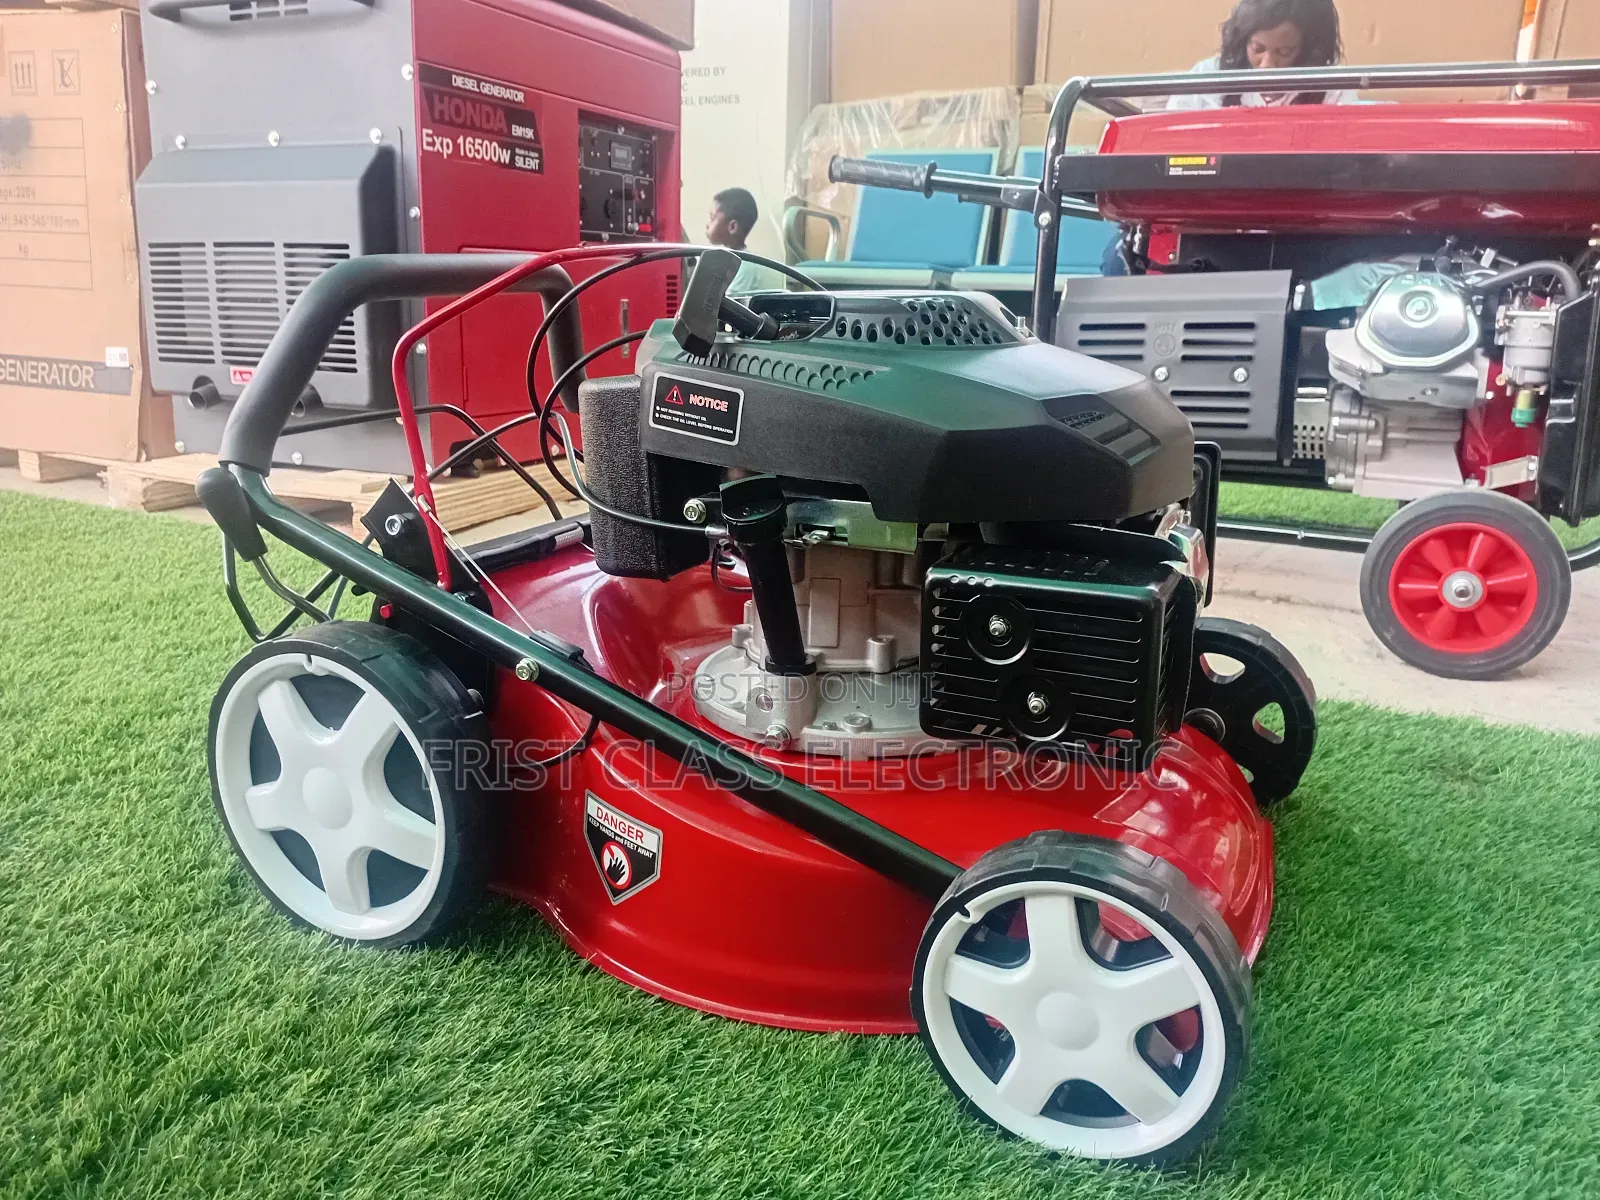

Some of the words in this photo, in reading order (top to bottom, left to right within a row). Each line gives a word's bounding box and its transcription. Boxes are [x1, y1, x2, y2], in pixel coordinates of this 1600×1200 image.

[452, 74, 479, 92] DIESEL
[480, 82, 525, 103] GENERATOR
[698, 94, 741, 105] ENGINES
[433, 92, 508, 134] HONDA
[422, 128, 453, 160] Exp
[512, 124, 535, 140] EM15K
[515, 156, 540, 171] SILENT
[18, 242, 29, 257] kg
[689, 393, 729, 412] NOTICE
[596, 806, 645, 844] DANGER
[588, 816, 600, 828] KEEP
[599, 824, 615, 839] HANDS
[615, 835, 624, 844] and
[624, 839, 638, 851] FEET
[637, 847, 654, 859] AWAY
